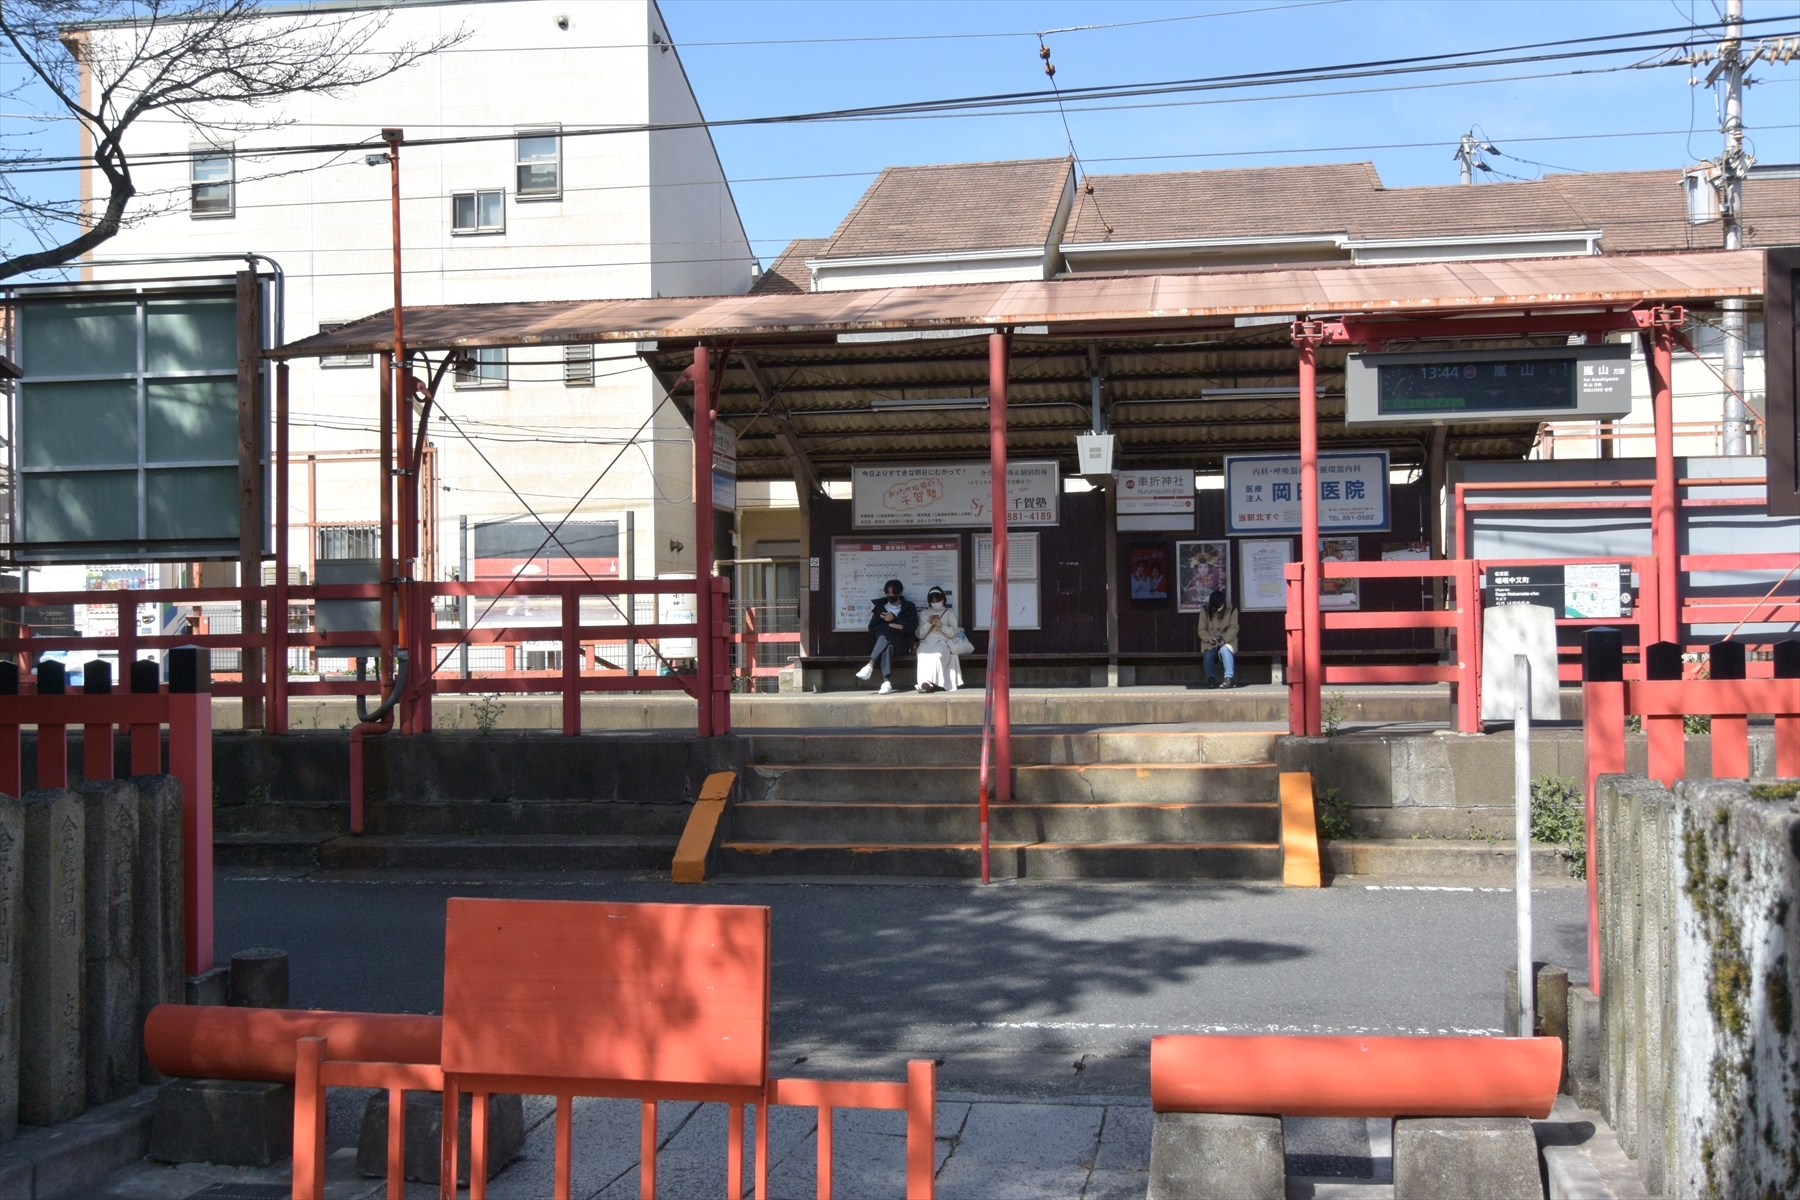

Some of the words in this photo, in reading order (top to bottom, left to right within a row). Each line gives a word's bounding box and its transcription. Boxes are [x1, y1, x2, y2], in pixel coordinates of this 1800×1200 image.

[1421, 366, 1459, 379] 13:44
[1138, 476, 1184, 487] 車折神社
[1245, 485, 1262, 493] 医療
[1272, 480, 1365, 502] 岡医院
[1011, 497, 1047, 509] 千賀塾
[1245, 494, 1262, 502] 法人
[1238, 513, 1279, 522] 当駅北すぐ
